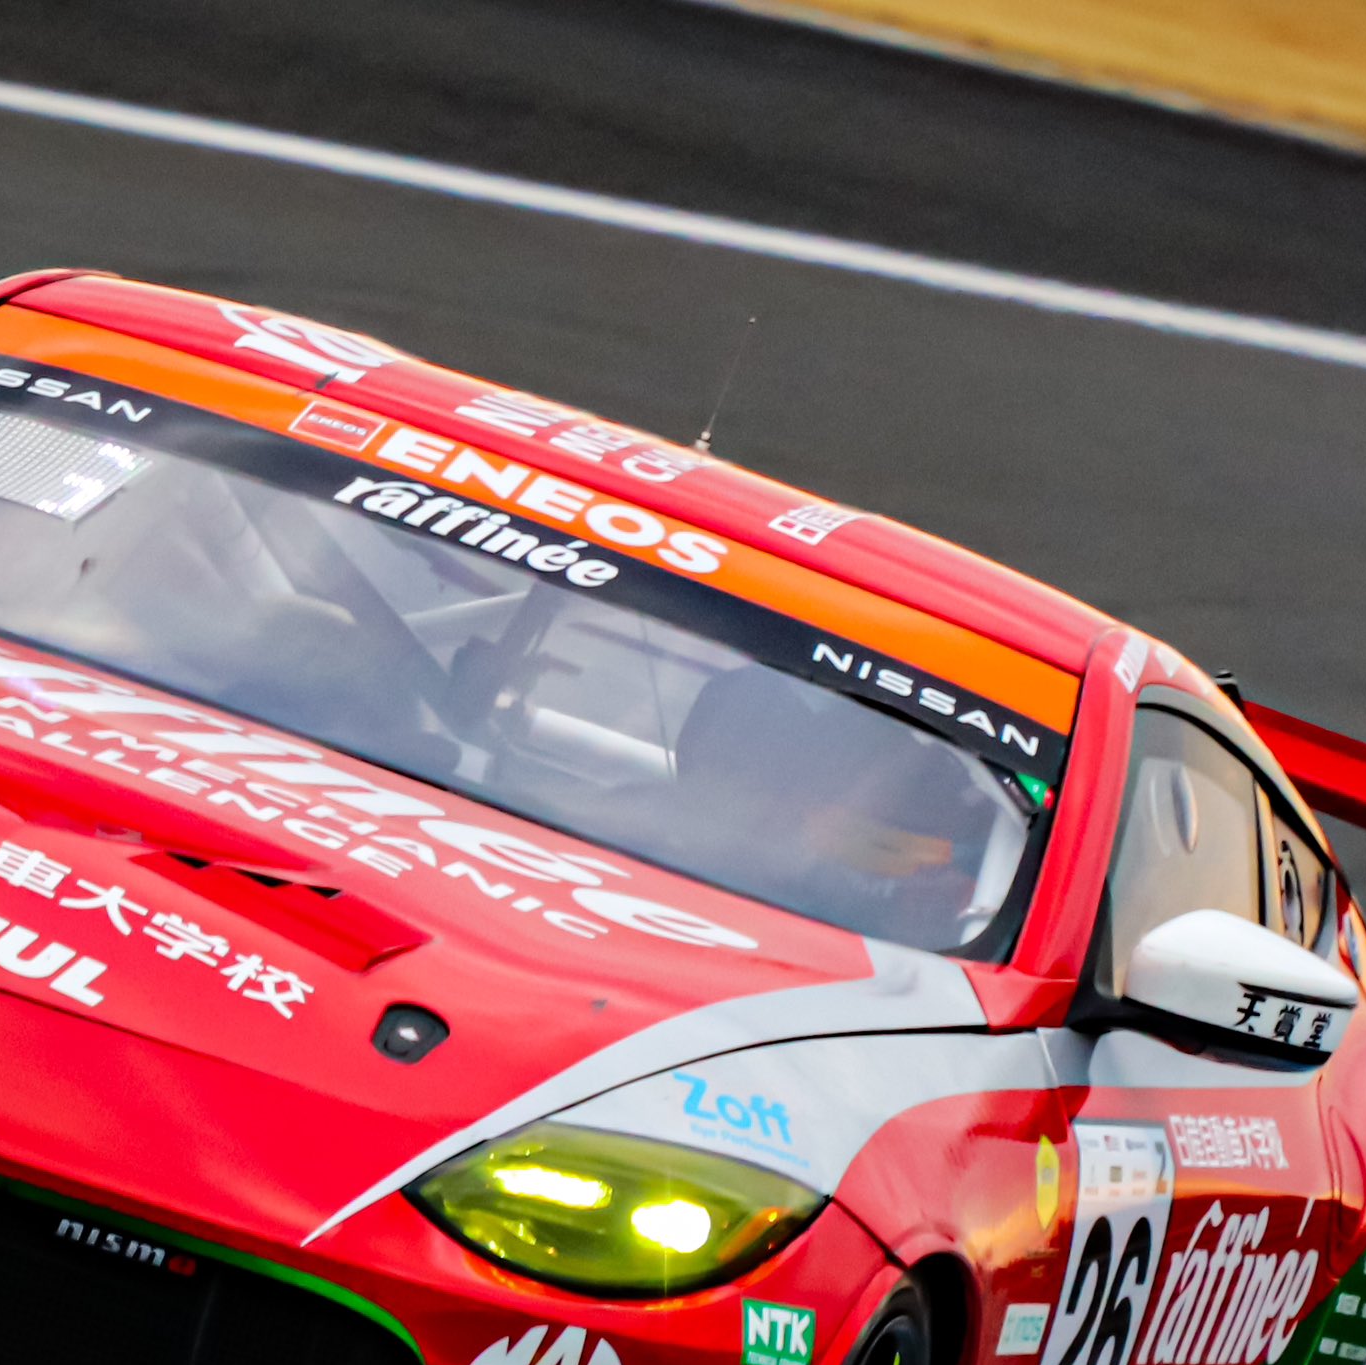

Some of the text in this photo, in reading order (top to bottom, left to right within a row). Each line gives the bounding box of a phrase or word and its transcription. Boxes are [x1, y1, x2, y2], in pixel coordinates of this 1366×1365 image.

[306, 412, 369, 437] ENEOS
[334, 476, 619, 588] raffinée
[377, 428, 728, 574] ENEOS
[813, 642, 1039, 757] NISSAN
[88, 729, 608, 938] MECHANIC
[672, 1071, 793, 1146] Zoff
[747, 1306, 810, 1358] NTK
